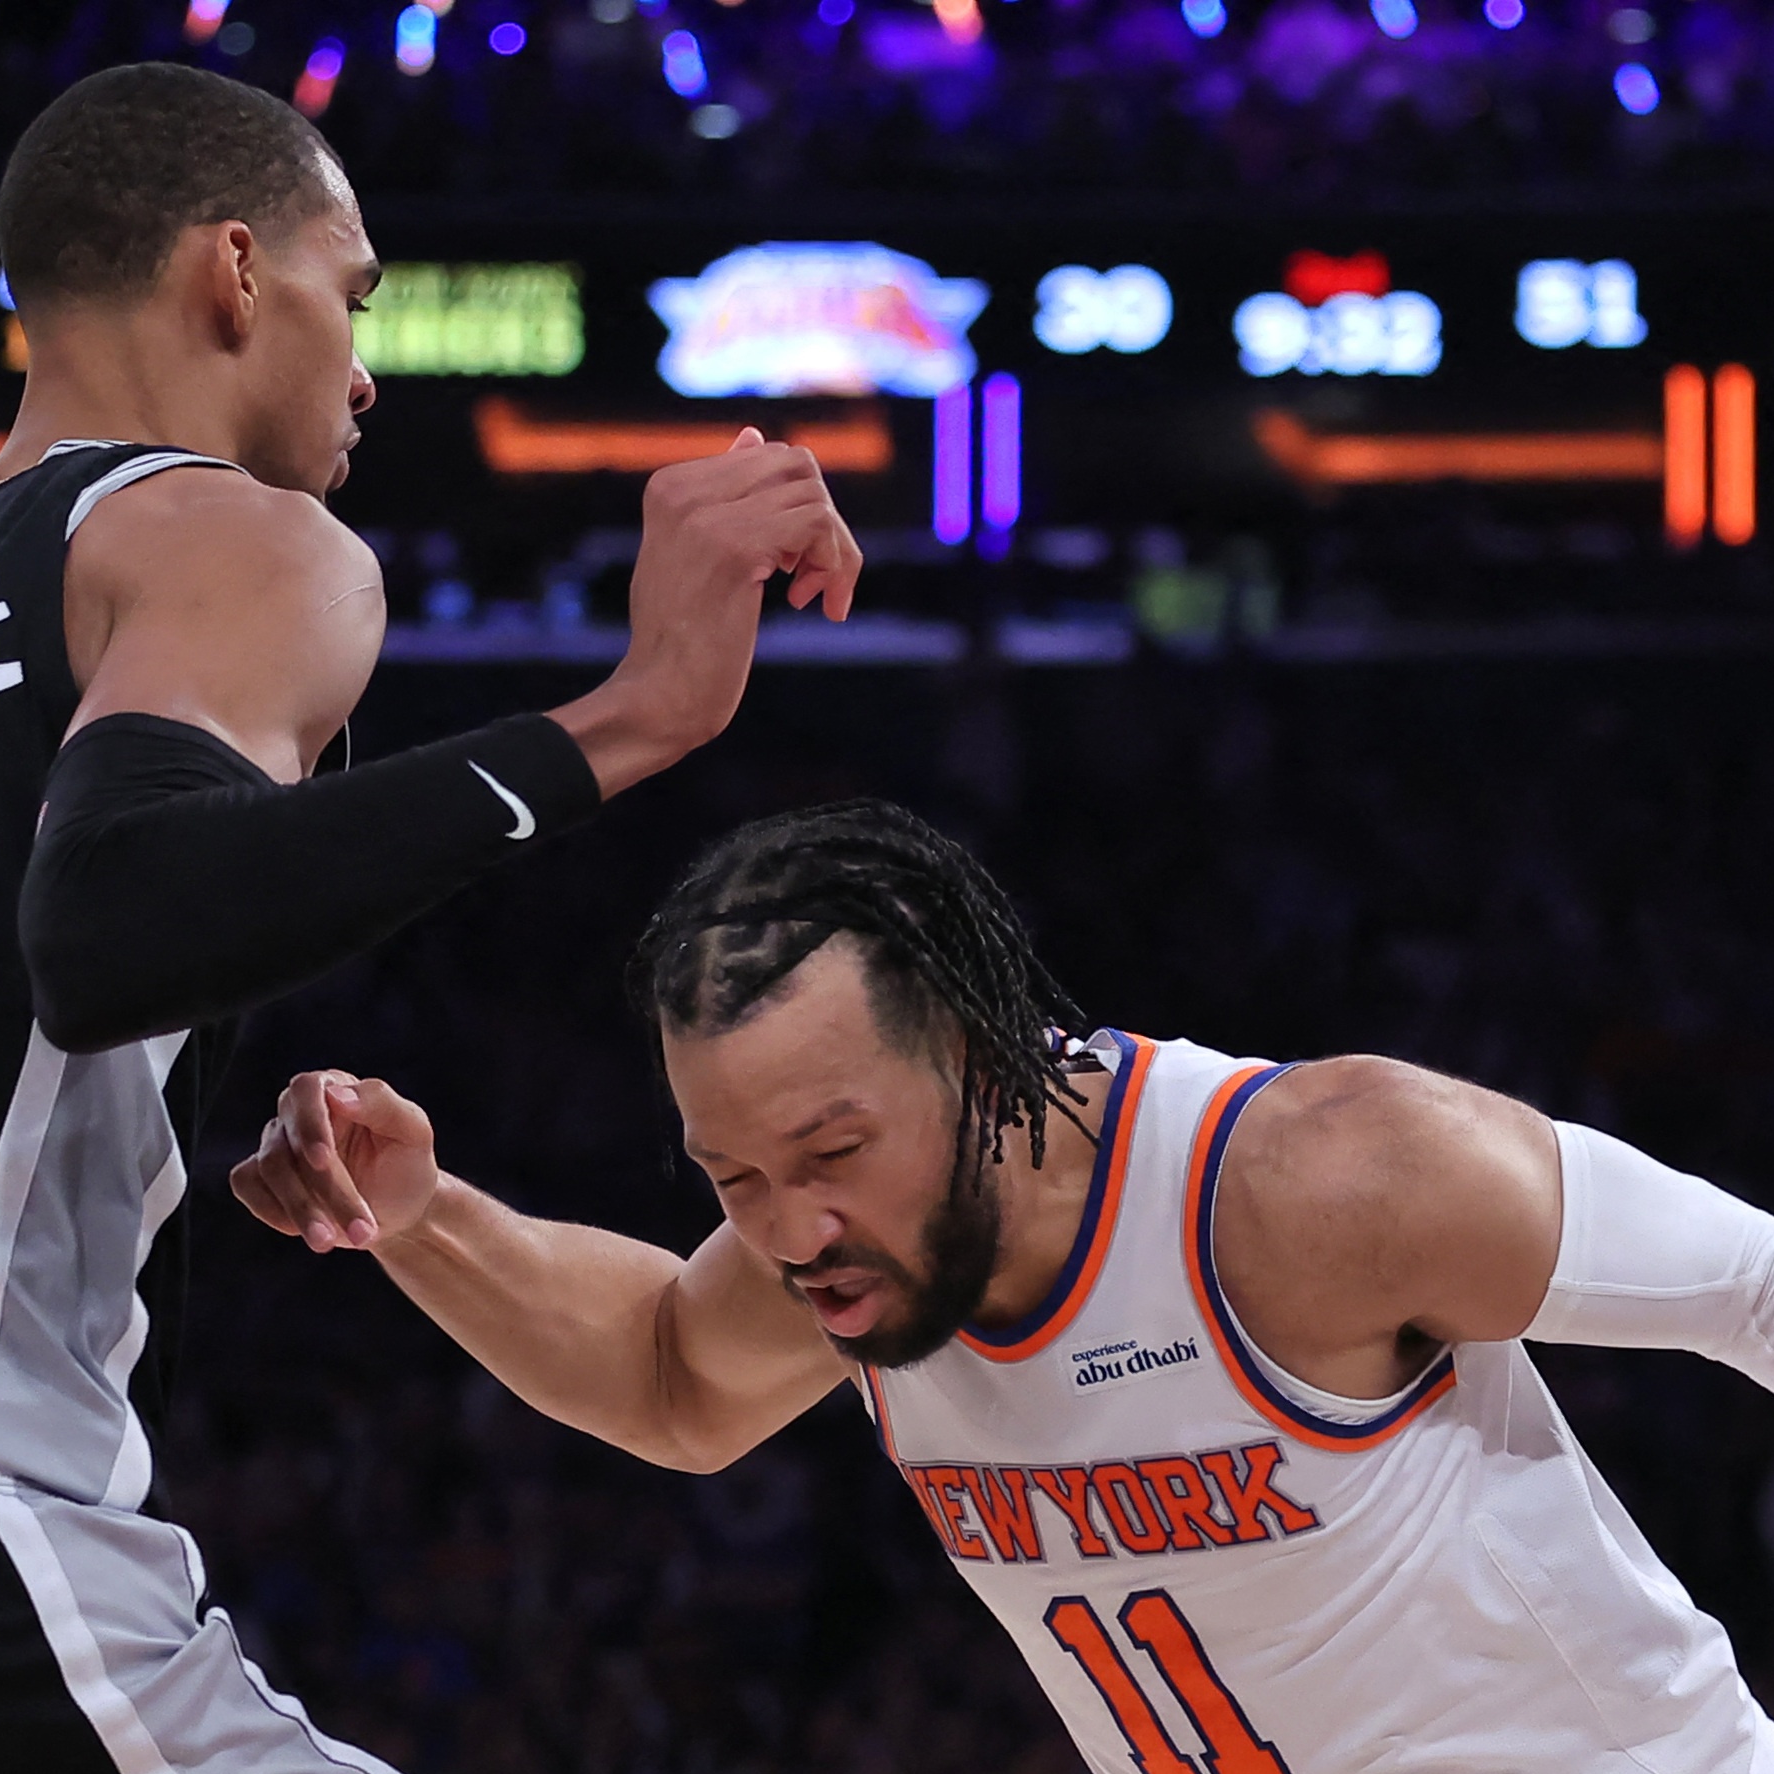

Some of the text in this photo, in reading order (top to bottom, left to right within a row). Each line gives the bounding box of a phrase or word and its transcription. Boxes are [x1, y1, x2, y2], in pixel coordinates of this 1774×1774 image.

[1071, 1339, 1138, 1363] experience
[1075, 1336, 1200, 1387] abu dhabi
[1024, 1440, 1323, 1560] YORK
